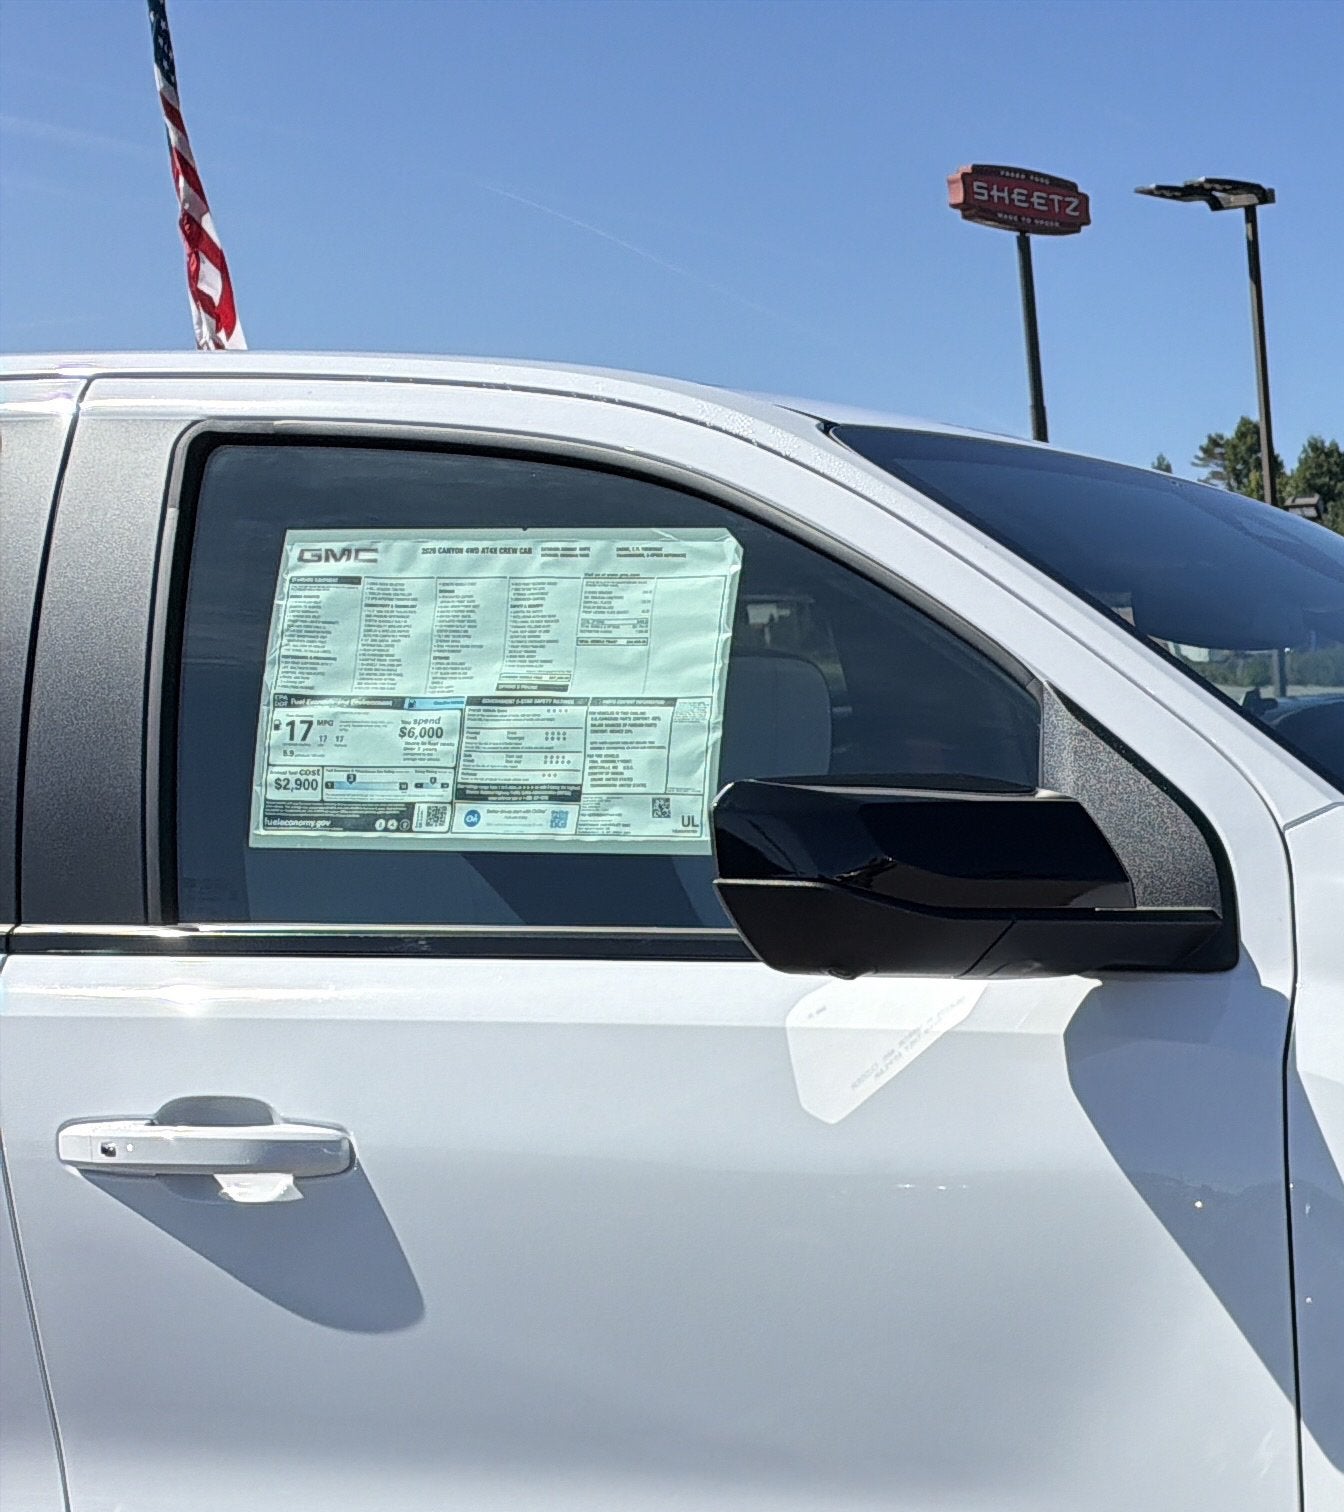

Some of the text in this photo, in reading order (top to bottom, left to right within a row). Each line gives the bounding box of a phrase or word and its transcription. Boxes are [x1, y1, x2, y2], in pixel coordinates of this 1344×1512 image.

[972, 181, 1080, 216] SHEETZ
[297, 548, 379, 563] GMC
[413, 716, 441, 726] spend
[285, 720, 314, 742] 17
[398, 727, 444, 740] $6,000
[275, 778, 319, 792] $2,900
[264, 818, 331, 829] fueleconomy.gov
[681, 815, 699, 827] UL
